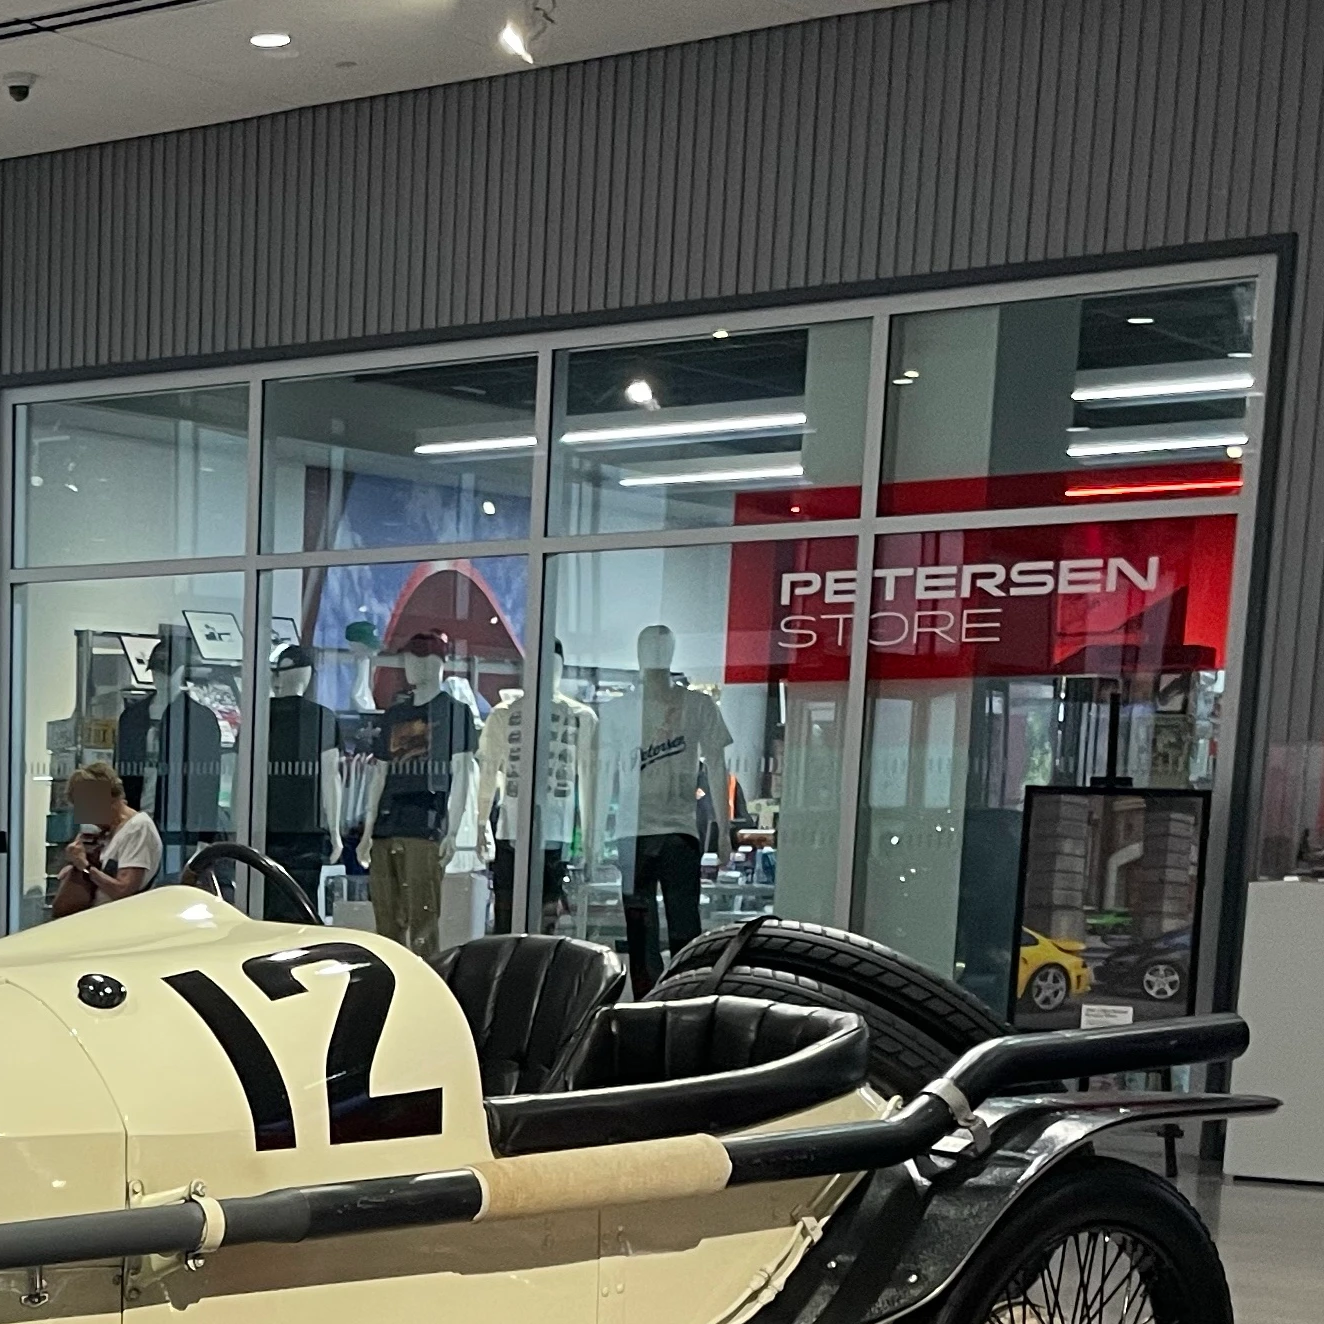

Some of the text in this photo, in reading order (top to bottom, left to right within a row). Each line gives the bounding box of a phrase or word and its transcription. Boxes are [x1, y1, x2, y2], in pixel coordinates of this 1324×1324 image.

[780, 556, 1160, 606] PETERSEN
[777, 608, 1003, 649] STORE
[161, 941, 444, 1152] 12
